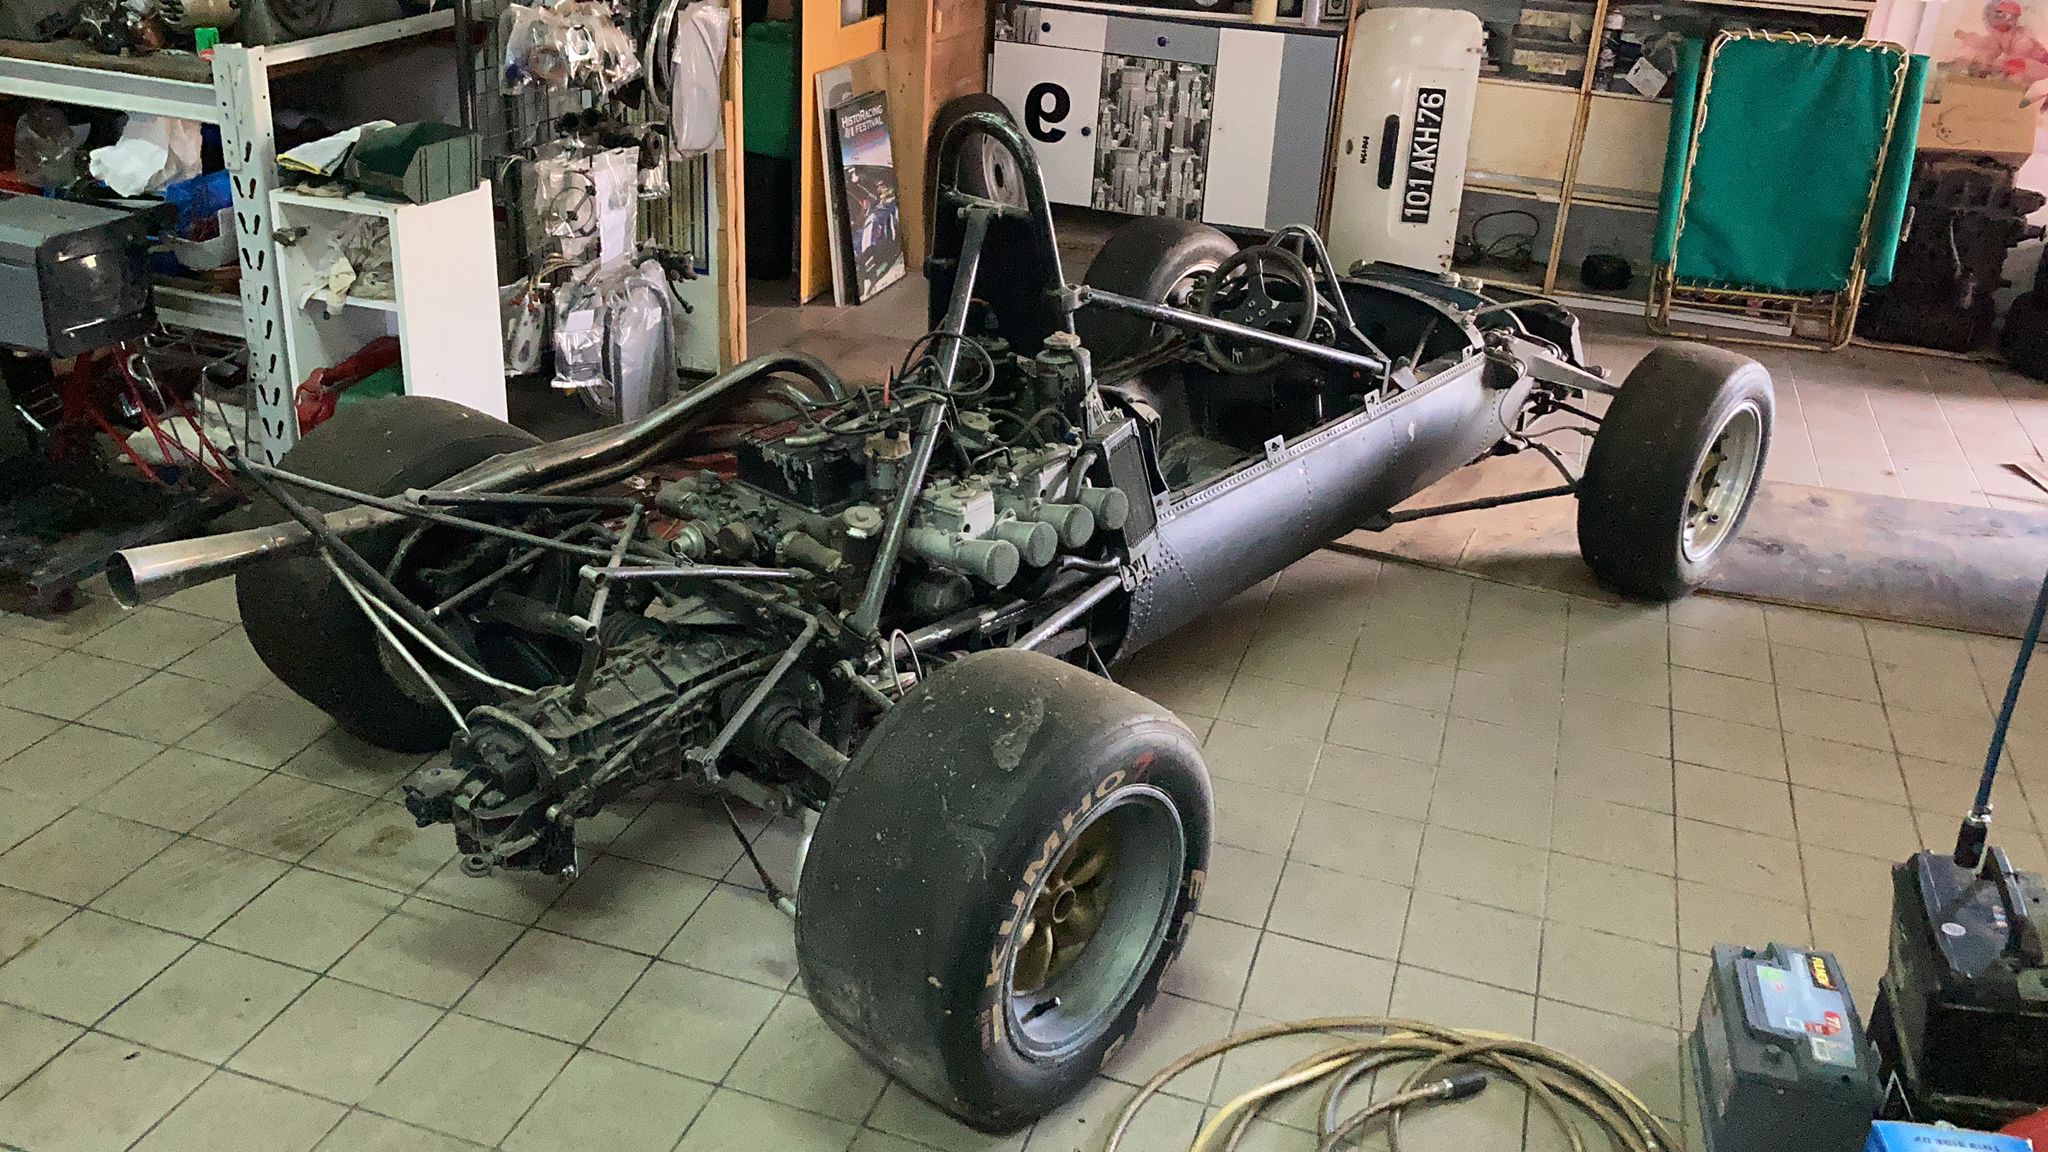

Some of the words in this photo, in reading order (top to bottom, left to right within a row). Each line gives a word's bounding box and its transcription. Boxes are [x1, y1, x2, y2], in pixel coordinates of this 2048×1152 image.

[855, 116, 883, 134] FESTIVAL
[1417, 93, 1444, 123] 76
[1410, 127, 1440, 173] AKH
[1404, 178, 1432, 217] 101
[984, 769, 1127, 988] KUMHO
